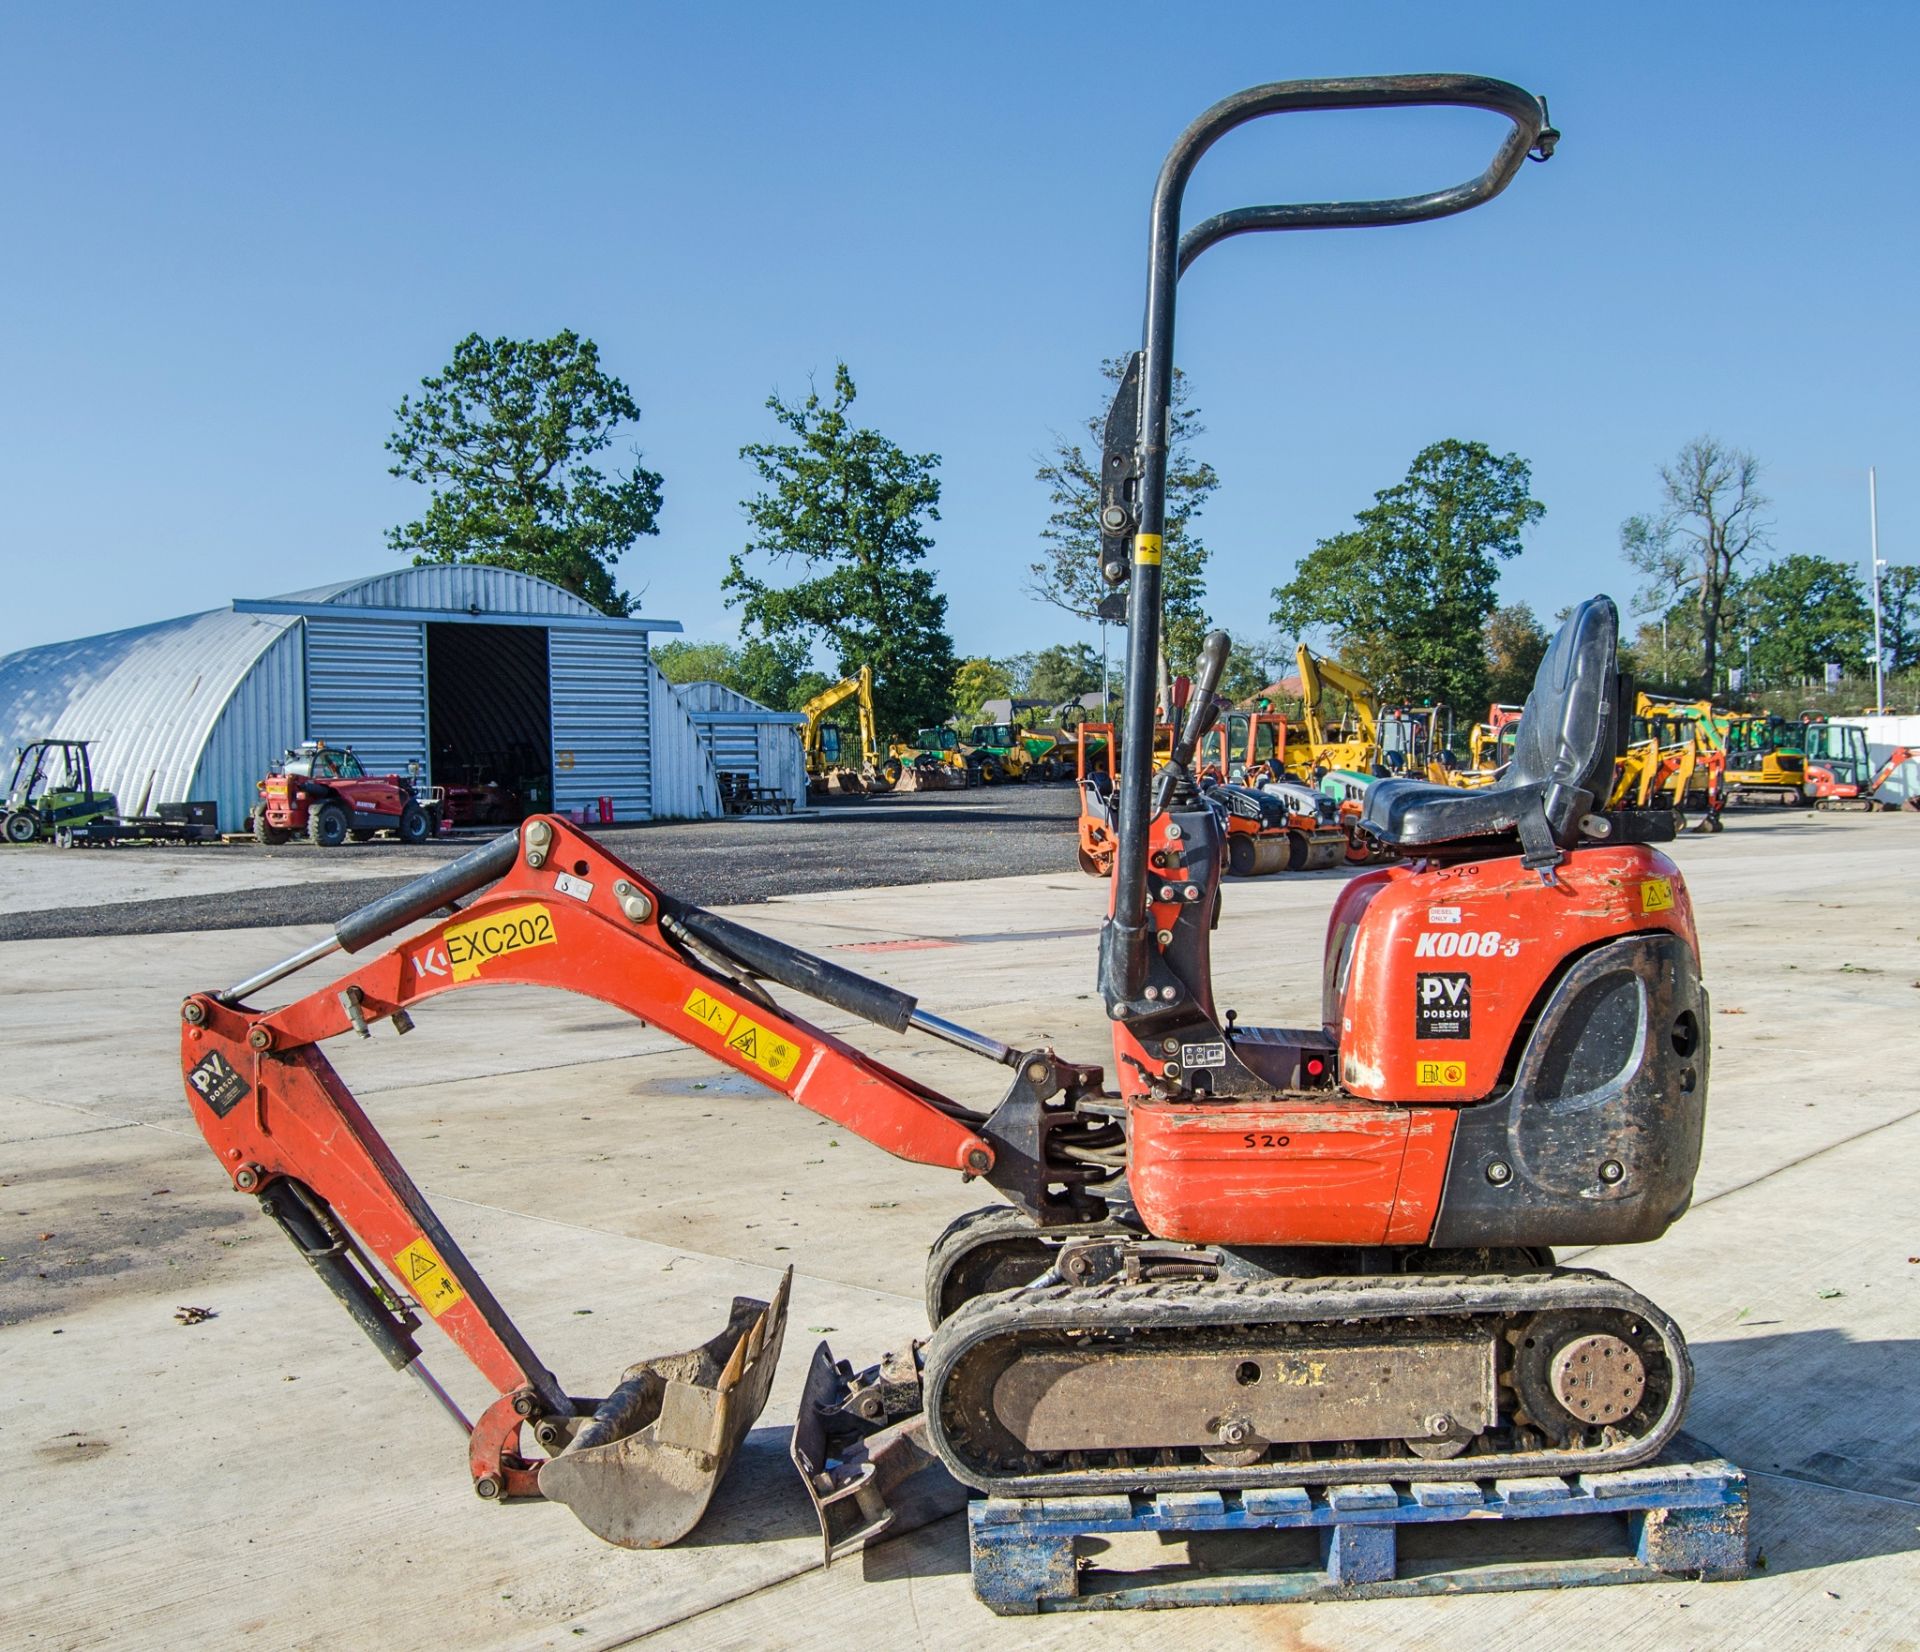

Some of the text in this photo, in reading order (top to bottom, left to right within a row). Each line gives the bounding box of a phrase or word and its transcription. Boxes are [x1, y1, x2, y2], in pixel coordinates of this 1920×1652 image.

[446, 915, 553, 964] EXC202
[1414, 931, 1520, 957] K008-3
[1420, 978, 1468, 1006] P.V.
[1423, 1009, 1468, 1018] DOBSON
[209, 1073, 238, 1101] DOBSON
